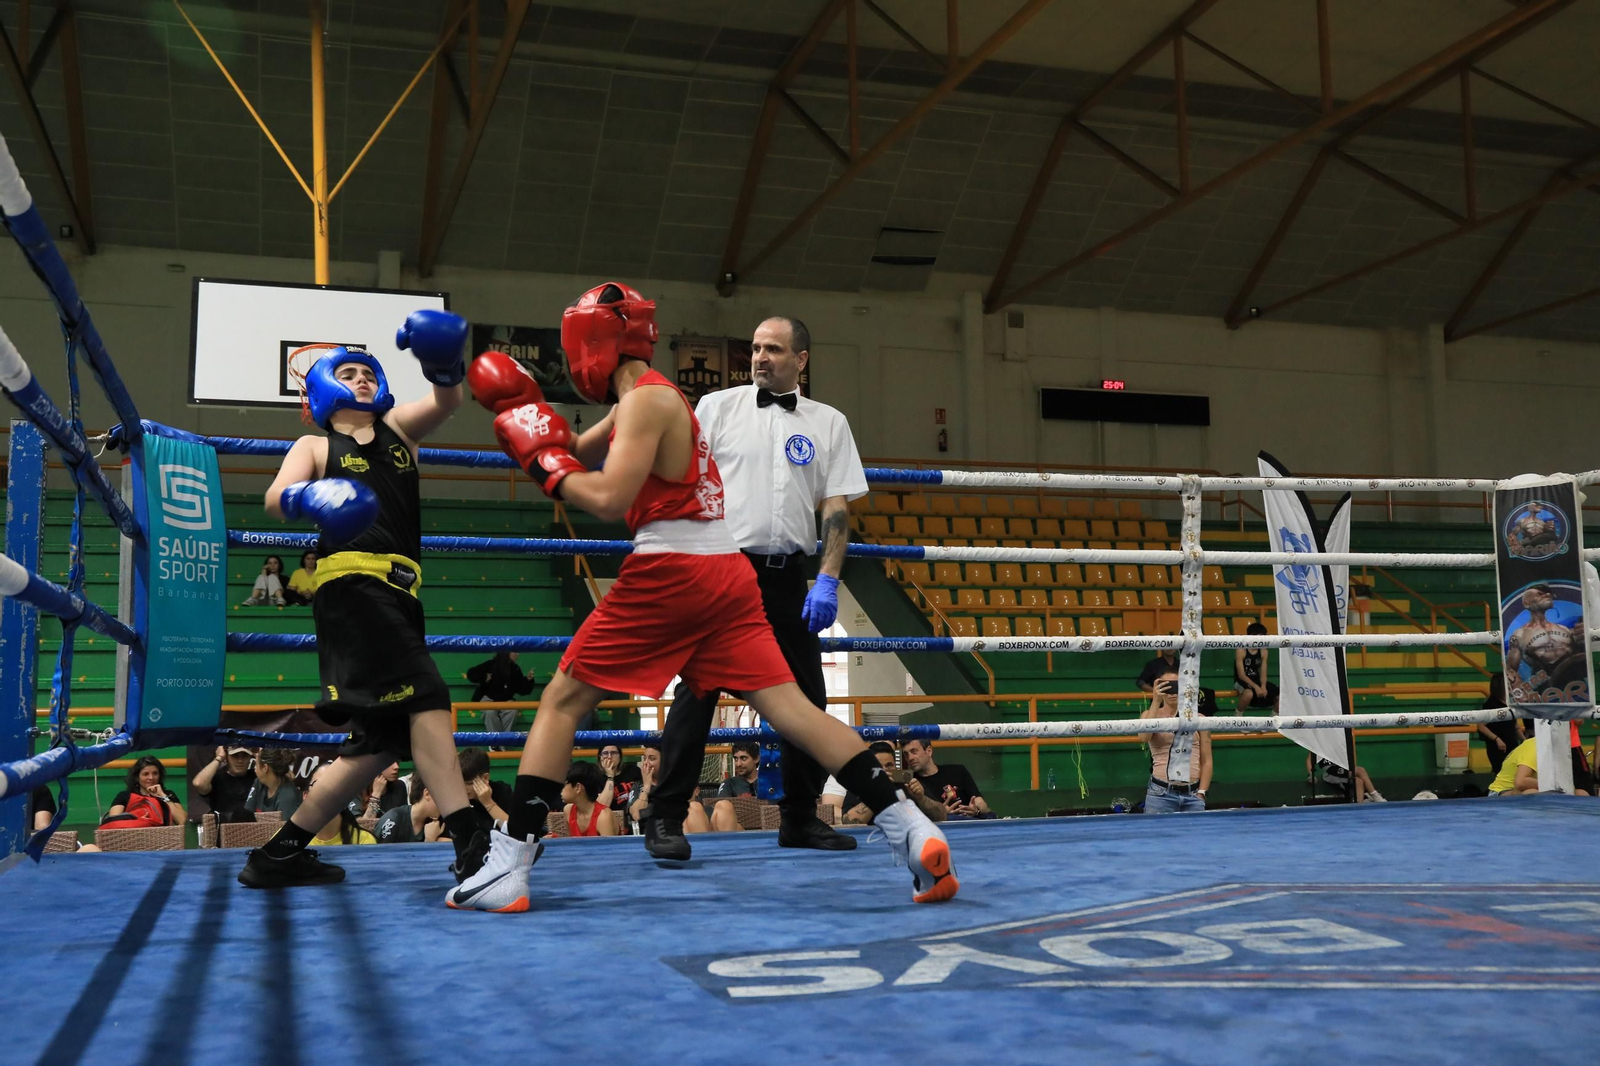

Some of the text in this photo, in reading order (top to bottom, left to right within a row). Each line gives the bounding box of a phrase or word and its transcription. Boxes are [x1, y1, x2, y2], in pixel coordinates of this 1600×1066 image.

[158, 535, 220, 562] SAÚDE
[158, 559, 219, 583] SPORT
[158, 587, 219, 601] Barbanza
[852, 641, 927, 650] BOXBRONX.COM
[999, 641, 1069, 650] BOXBRONX.COM
[1105, 640, 1173, 649] BOXBRONX.COM
[156, 678, 214, 688] PORTO DO SON
